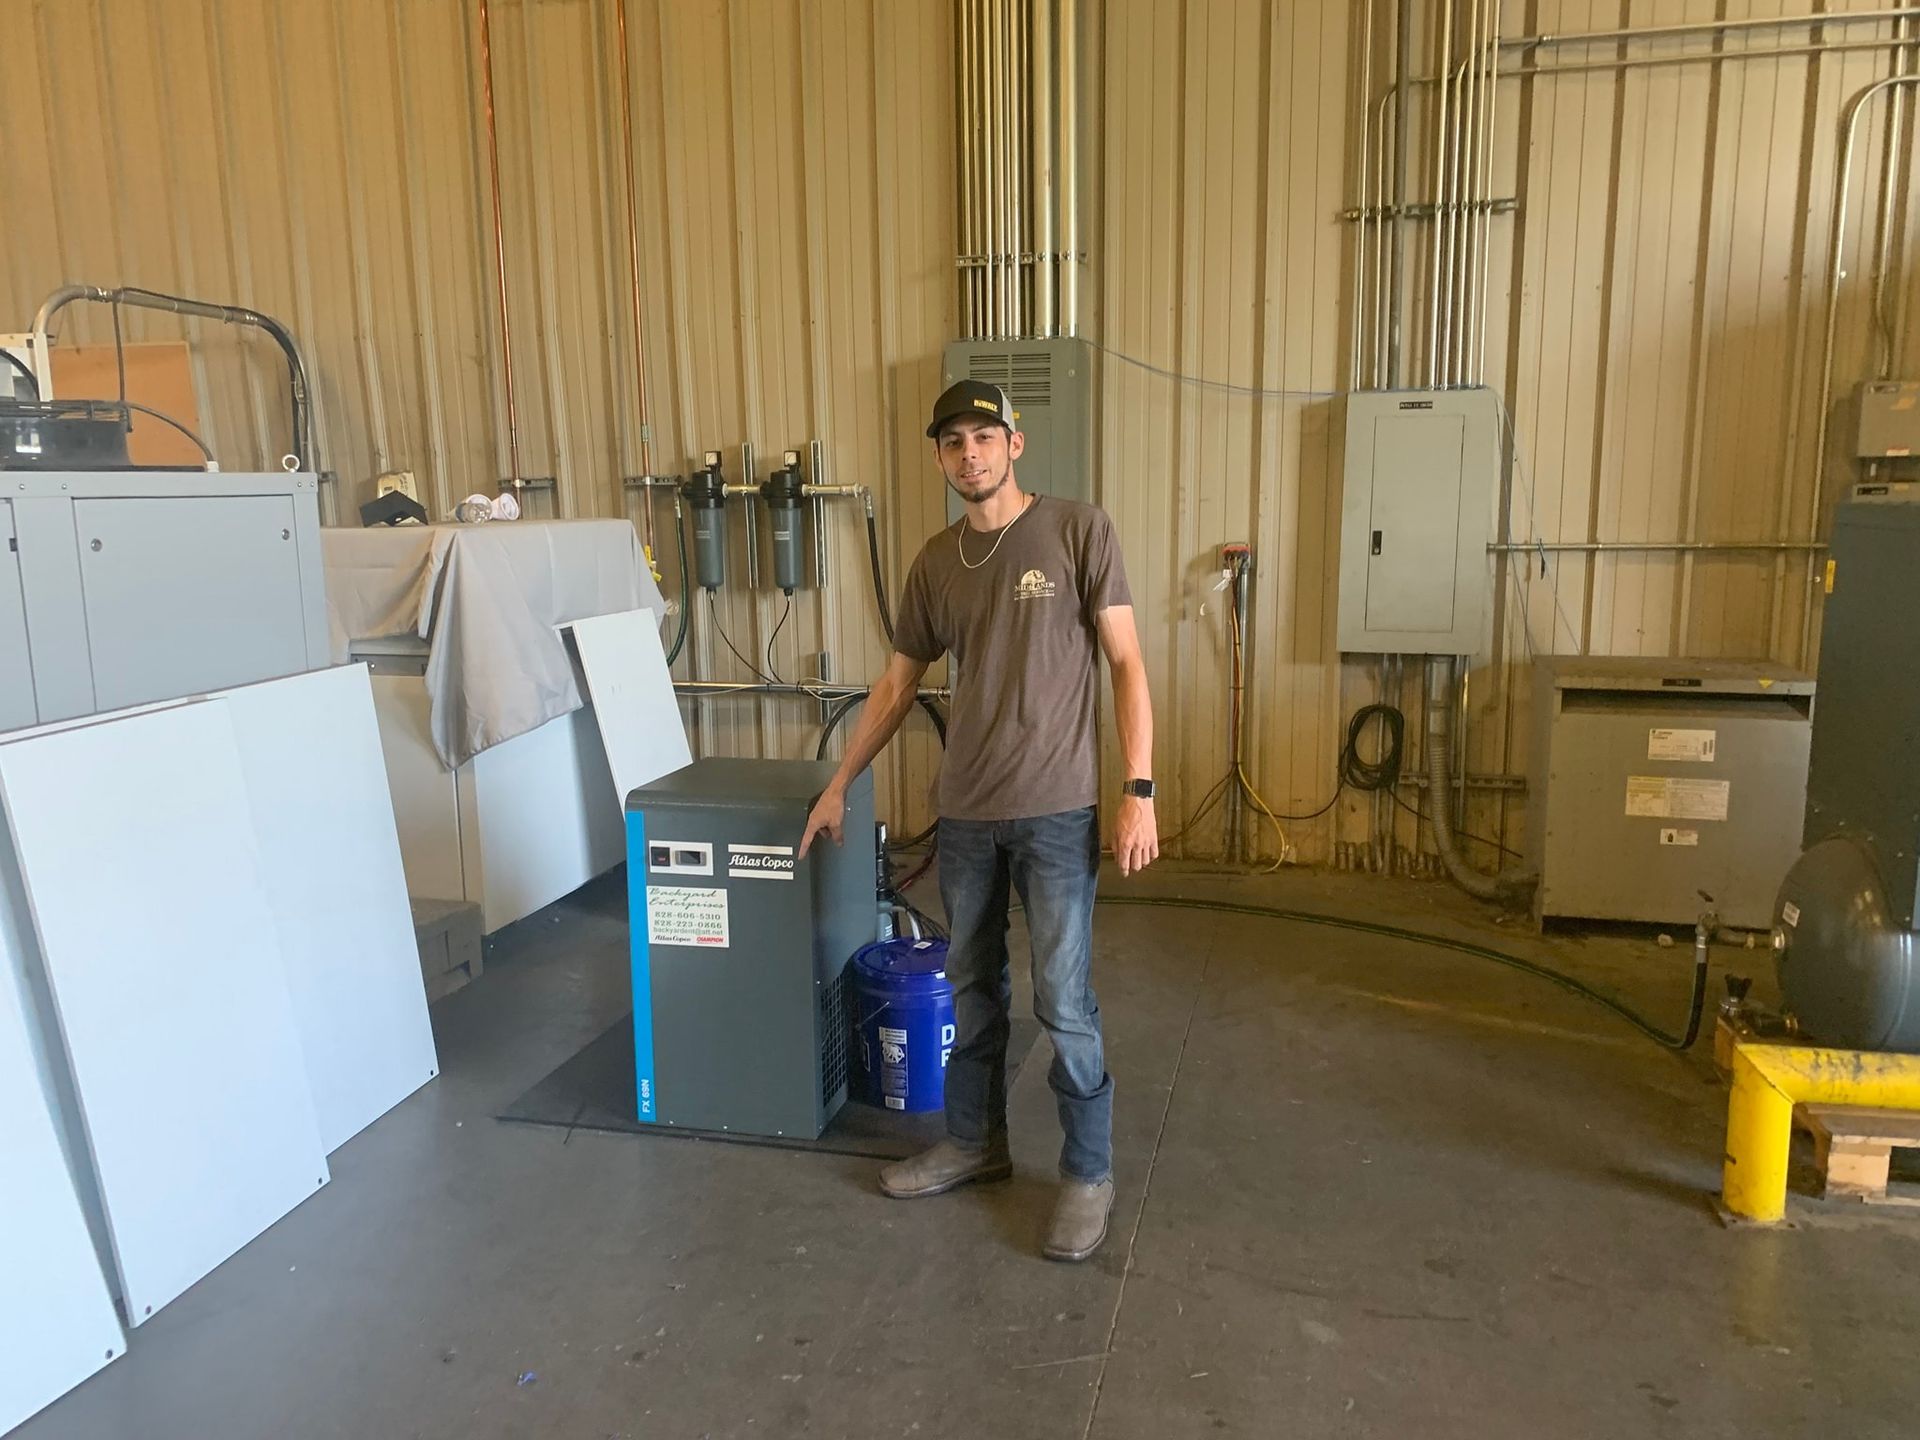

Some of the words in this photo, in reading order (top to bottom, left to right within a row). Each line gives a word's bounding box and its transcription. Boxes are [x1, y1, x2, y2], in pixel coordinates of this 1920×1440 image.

[728, 854, 761, 867] Atlas
[761, 855, 794, 870] Copco
[649, 887, 717, 902] Backyard
[649, 897, 725, 911] Enterprises
